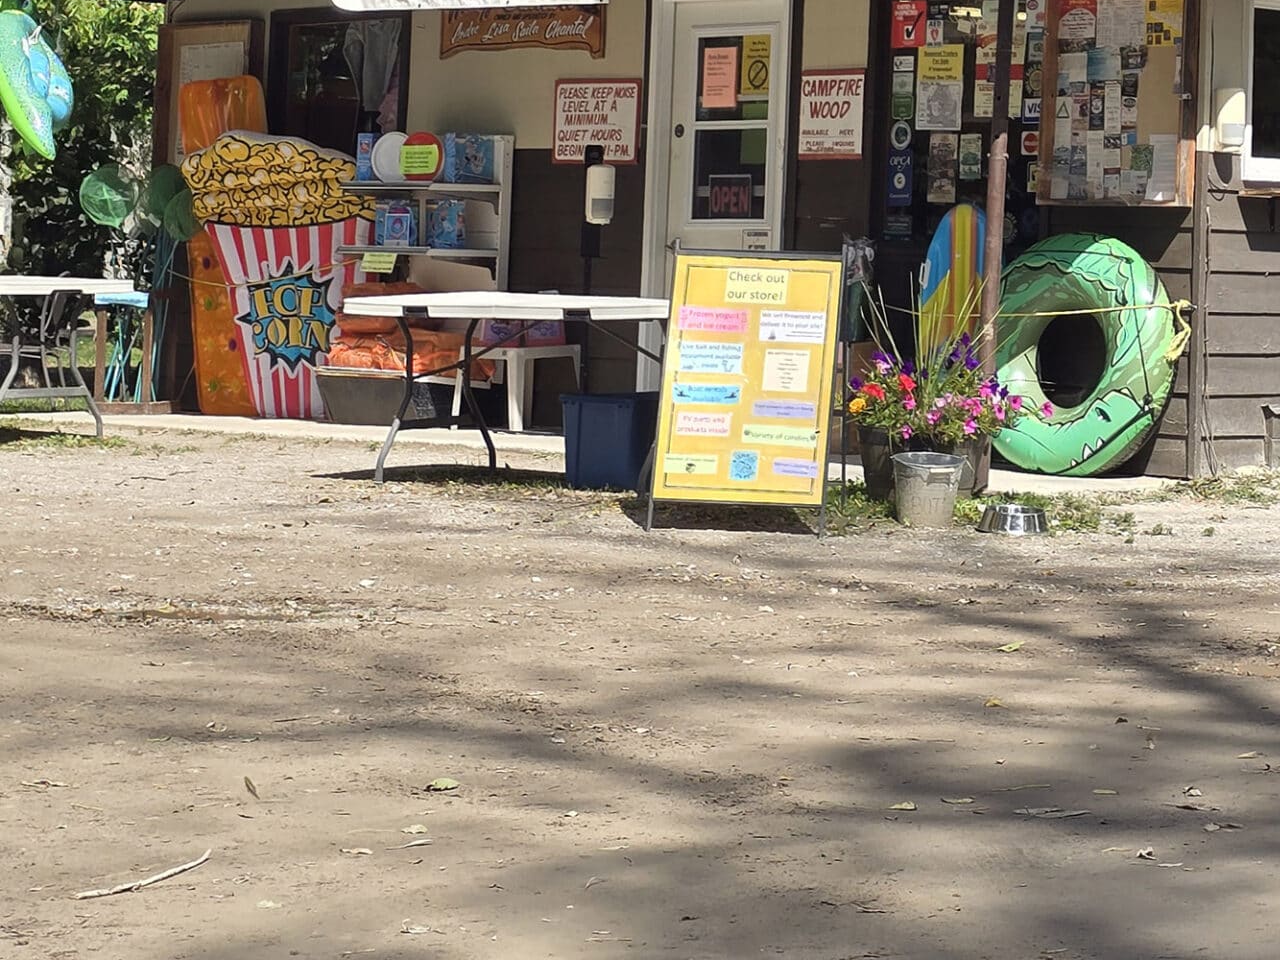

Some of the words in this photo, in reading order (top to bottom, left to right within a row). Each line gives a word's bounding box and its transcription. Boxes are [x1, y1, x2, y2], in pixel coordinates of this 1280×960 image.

[480, 22, 510, 43] Lisa
[544, 15, 594, 41] Chantal
[559, 86, 590, 100] PLEASE
[590, 86, 613, 99] KEEP
[613, 86, 637, 99] NOISE
[802, 79, 863, 97] CAMPFIRE
[562, 100, 590, 113] LEVEL
[593, 100, 607, 113] AT
[610, 100, 618, 112] A
[809, 101, 851, 119] WOOD
[1027, 102, 1042, 114] VIS
[558, 129, 589, 142] QUIET
[590, 129, 623, 141] HOURS
[838, 128, 855, 136] HERE
[711, 186, 749, 214] OPEN
[728, 271, 762, 283] Check
[766, 274, 785, 284] out
[250, 283, 324, 319] POP
[727, 290, 747, 300] our
[749, 290, 783, 301] store!
[689, 309, 714, 318] Frozen
[715, 311, 740, 321] yogurt
[252, 317, 330, 352] CORN
[721, 344, 742, 352] fishing
